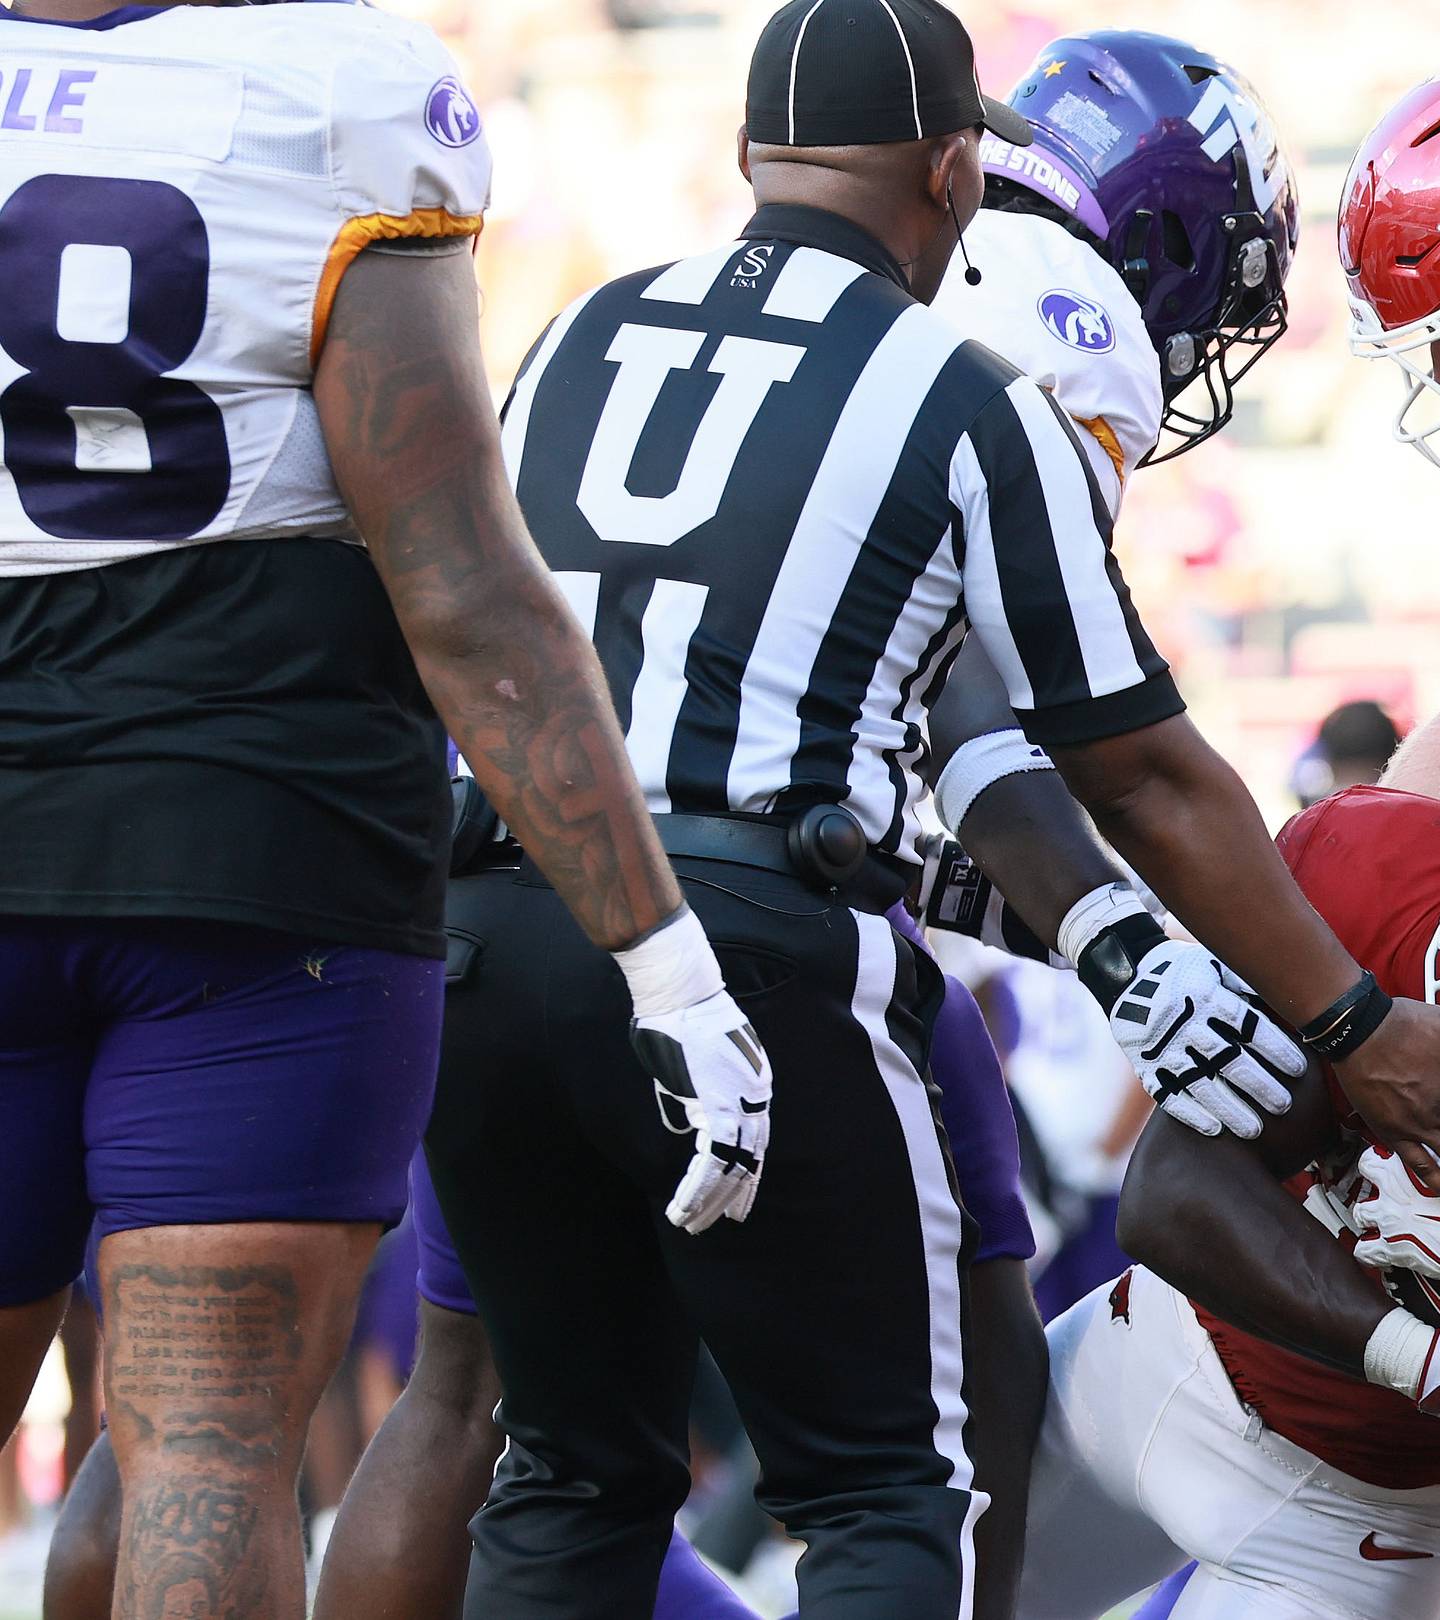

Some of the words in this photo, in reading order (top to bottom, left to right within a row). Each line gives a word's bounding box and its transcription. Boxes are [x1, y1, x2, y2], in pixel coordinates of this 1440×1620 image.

[0, 68, 98, 134] LE
[1006, 145, 1081, 210] STONE
[729, 277, 757, 289] USA
[0, 173, 231, 540] 8
[575, 322, 807, 547] U
[1330, 1023, 1353, 1047] PLAY
